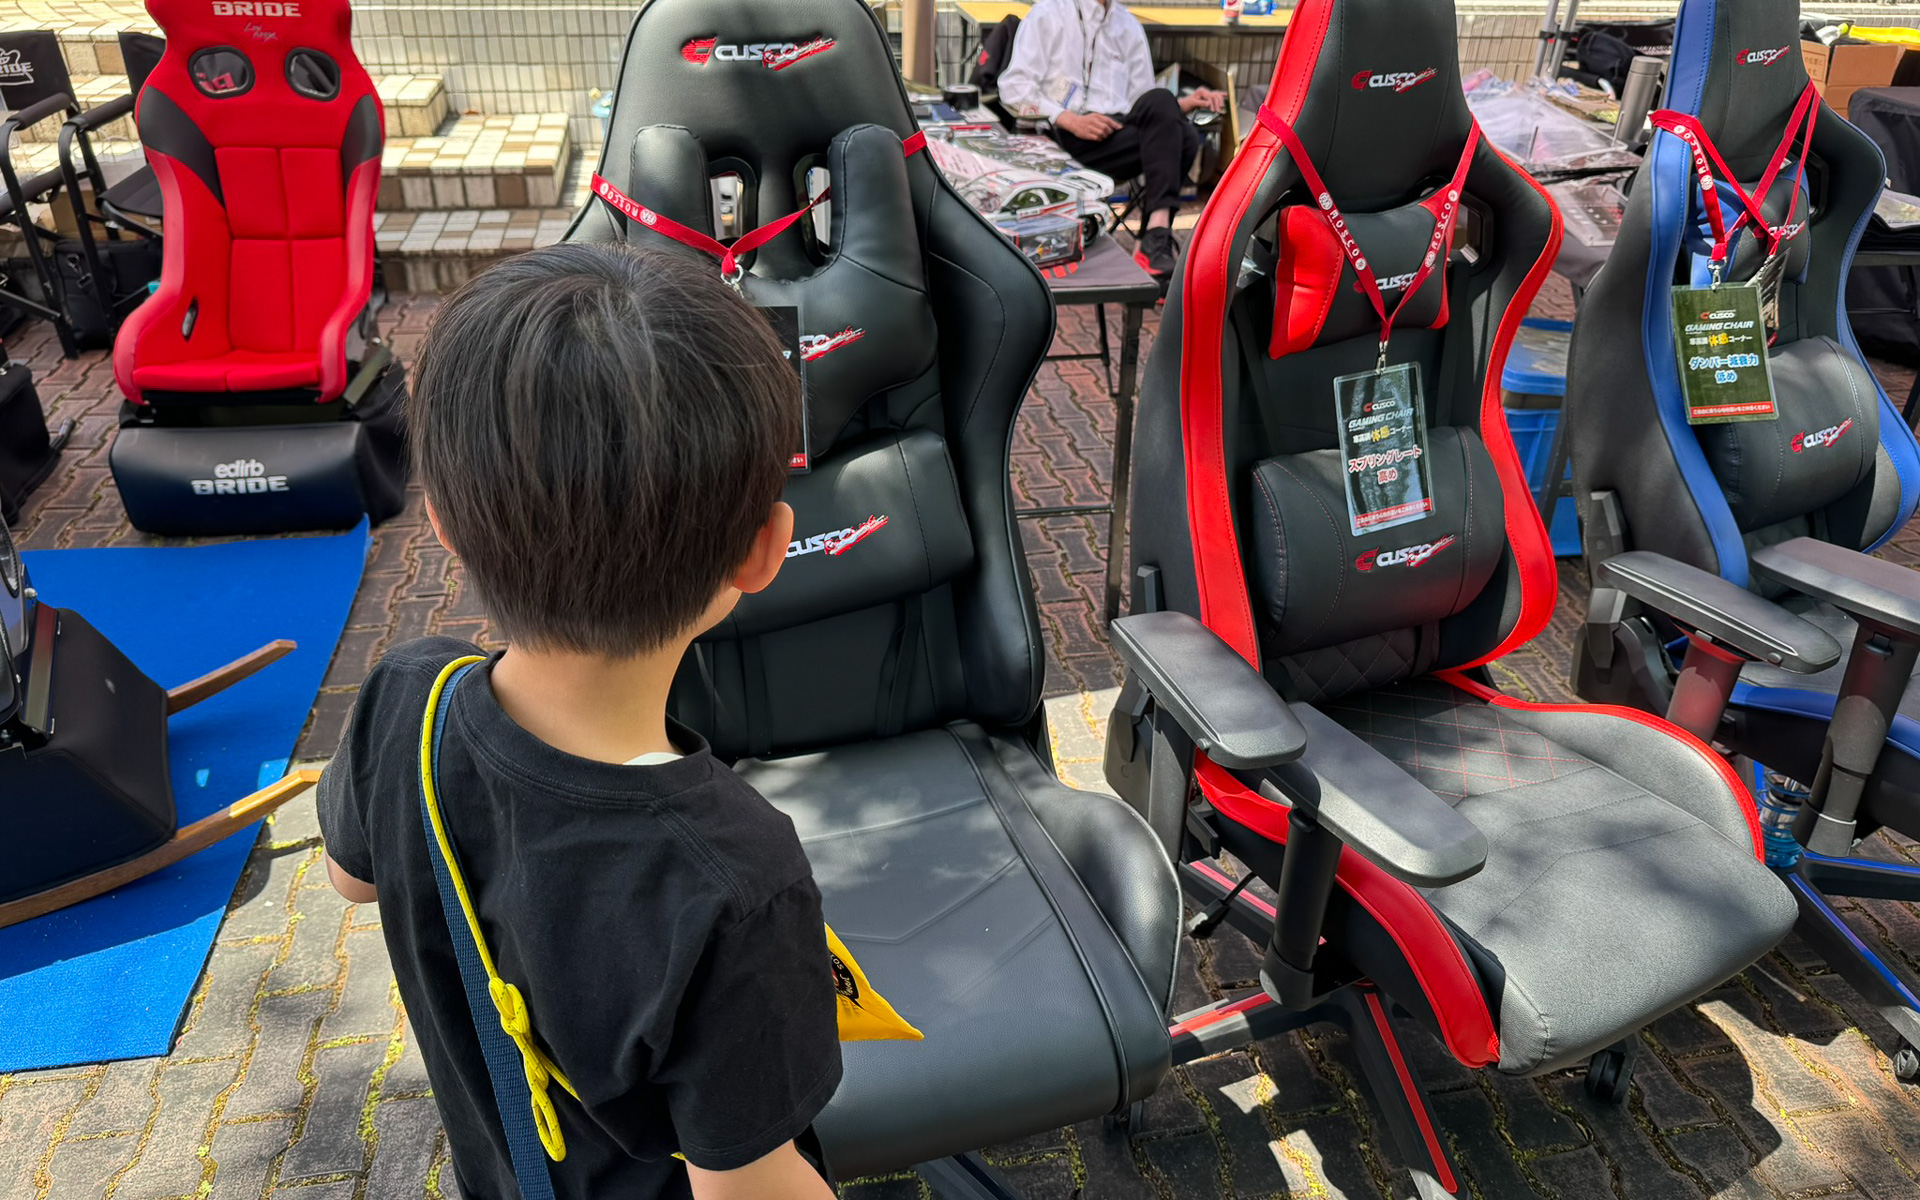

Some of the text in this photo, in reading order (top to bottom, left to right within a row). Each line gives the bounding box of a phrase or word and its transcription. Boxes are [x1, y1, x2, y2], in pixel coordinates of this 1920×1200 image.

[211, 1, 302, 17] BRIDE
[714, 43, 798, 62] CUSCO
[0, 61, 34, 74] IDE
[1329, 208, 1361, 257] MOSCO
[1432, 202, 1452, 250] MOSCO
[1684, 320, 1755, 333] GAMING CHAIR
[1348, 414, 1386, 429] GAMING
[1385, 407, 1414, 421] CHAIR
[214, 459, 265, 479] edirb
[1348, 444, 1422, 474] スプリングレート
[191, 475, 290, 496] BRIDE
[1377, 467, 1398, 484] 高め
